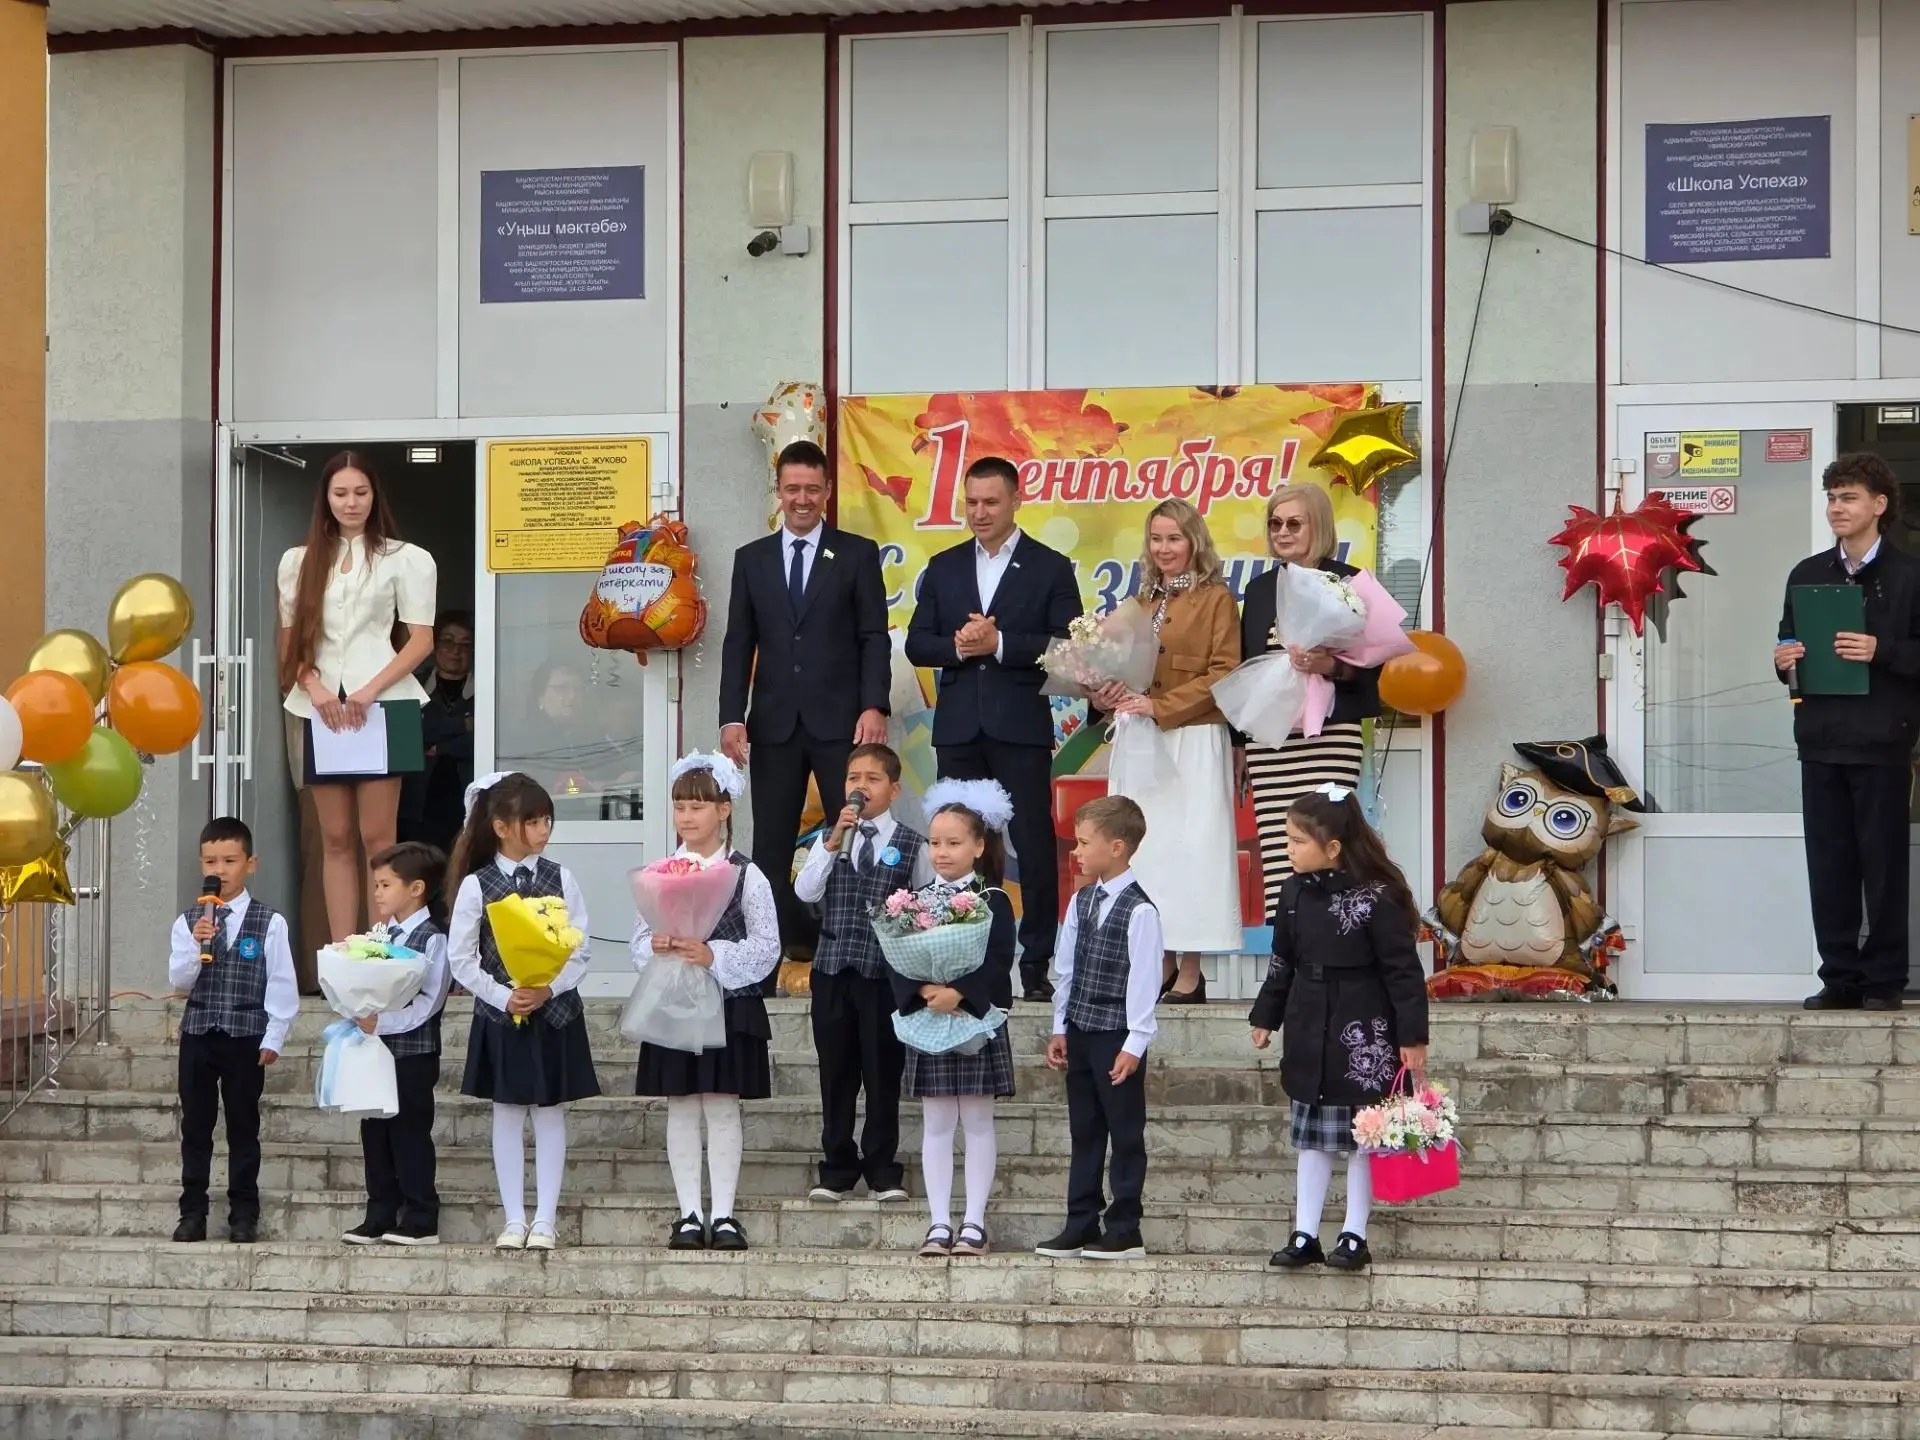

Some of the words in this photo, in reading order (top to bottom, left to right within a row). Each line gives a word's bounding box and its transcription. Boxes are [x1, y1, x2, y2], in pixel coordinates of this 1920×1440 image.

[1668, 177, 1733, 192] «Школа
[1738, 174, 1808, 190] Успеха»
[498, 222, 550, 237] «Уңыш
[556, 219, 627, 235] мәктәбе»
[1650, 436, 1676, 444] ОБЪЕКТ
[510, 458, 542, 466] «ШКОЛА
[544, 457, 580, 466] УСПЕХА»
[592, 456, 627, 464] ЖУКОВО
[914, 419, 969, 531] 1
[1007, 436, 1301, 517] ентября!
[1664, 491, 1708, 500] РЕНИЕ
[609, 566, 647, 577] школу
[598, 578, 664, 591] пятёрками
